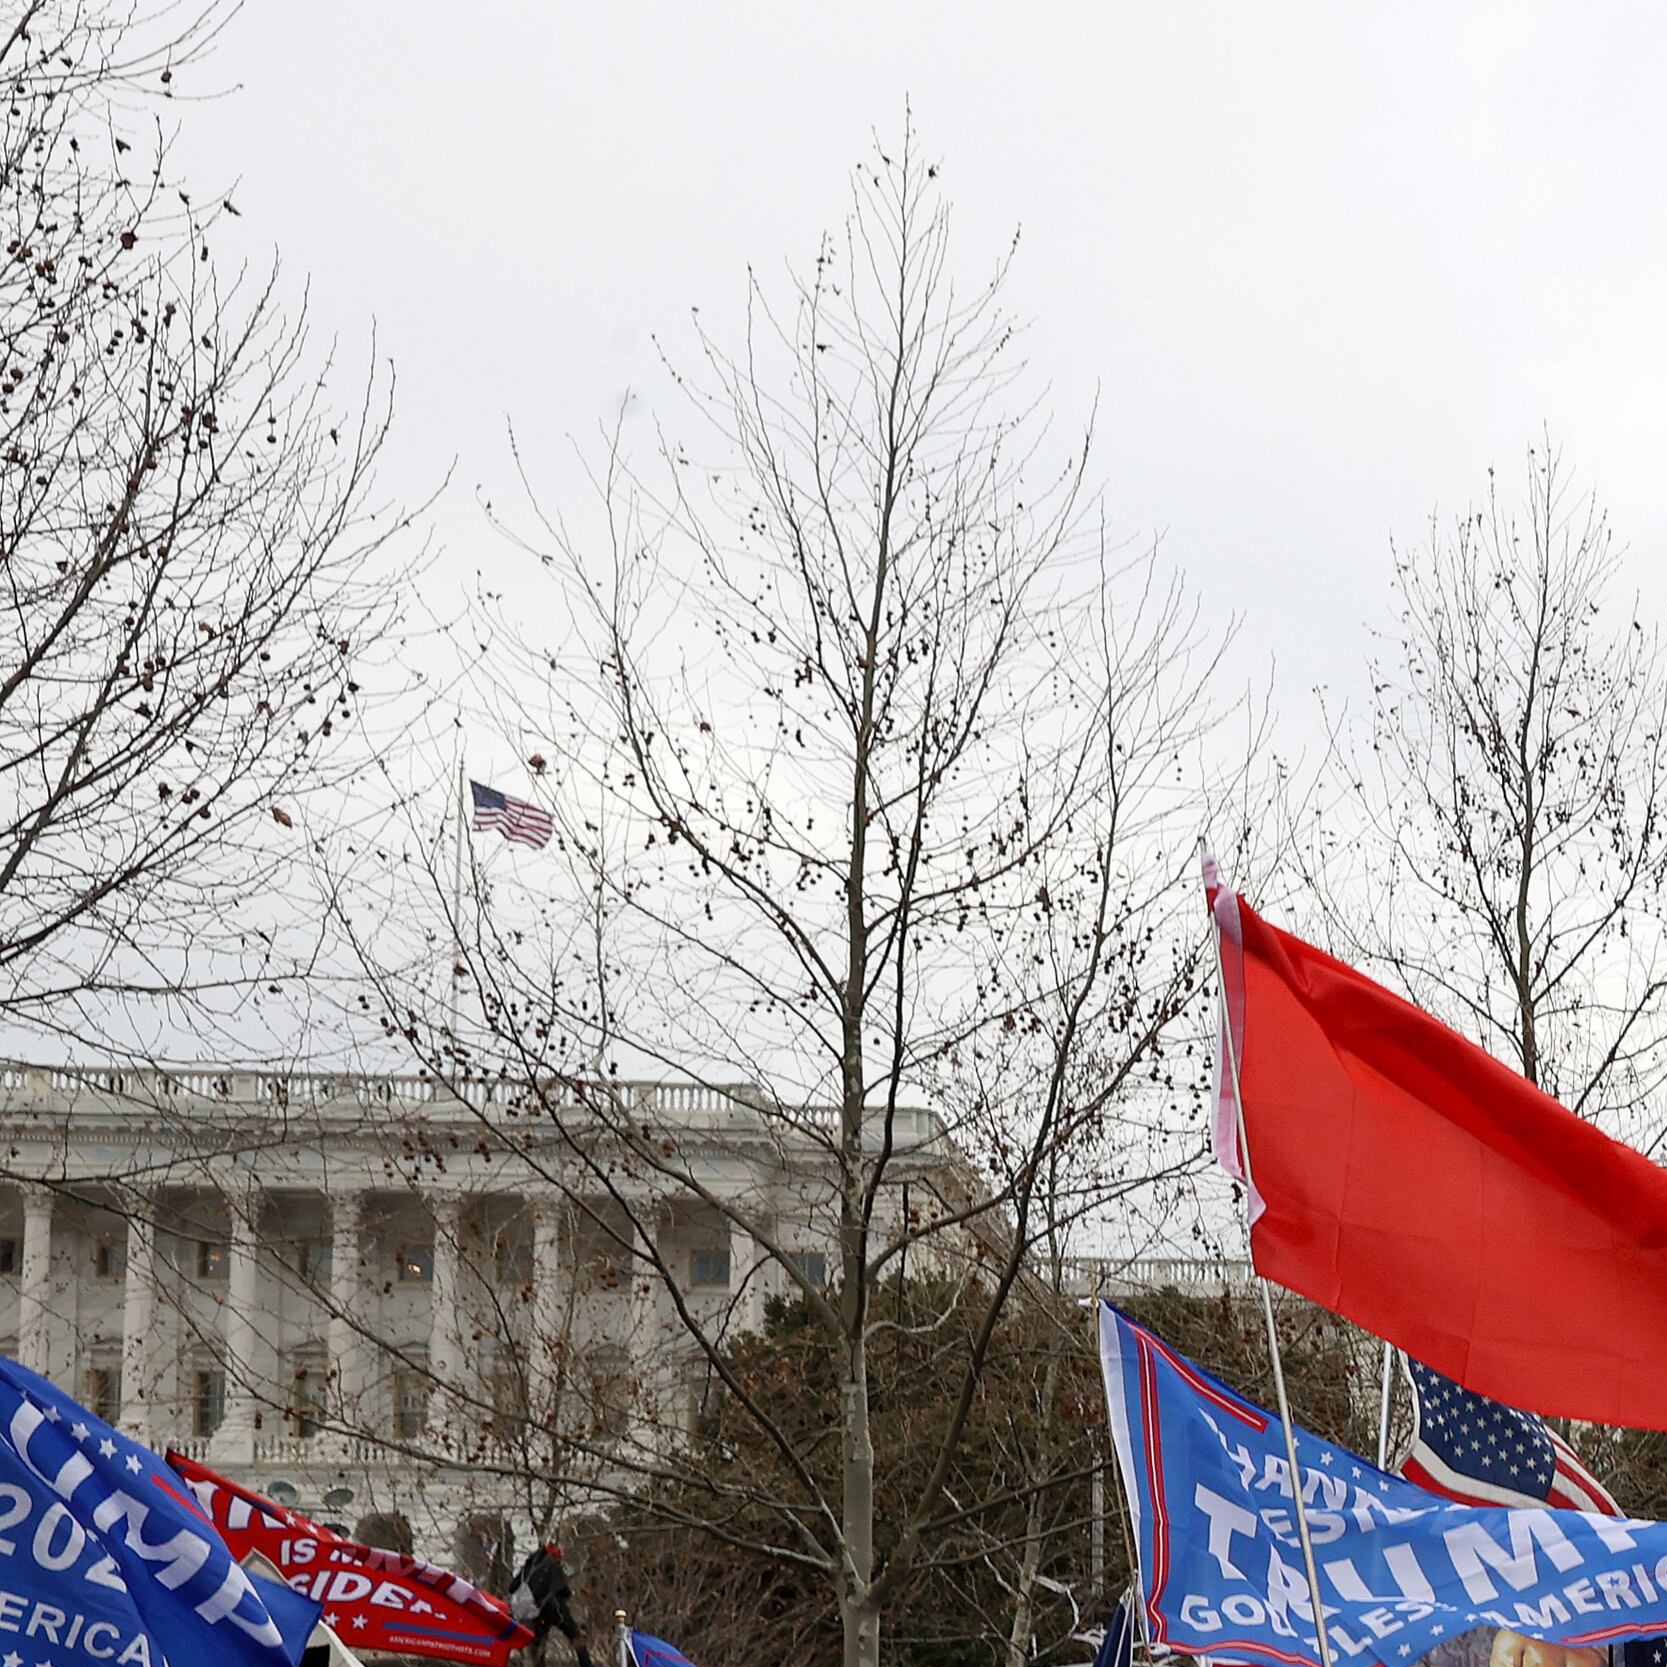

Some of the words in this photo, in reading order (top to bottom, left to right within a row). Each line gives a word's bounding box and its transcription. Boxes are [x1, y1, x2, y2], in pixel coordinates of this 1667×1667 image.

[0, 1482, 128, 1595] 202
[281, 1537, 320, 1566] IS
[1179, 1592, 1298, 1640] GOD
